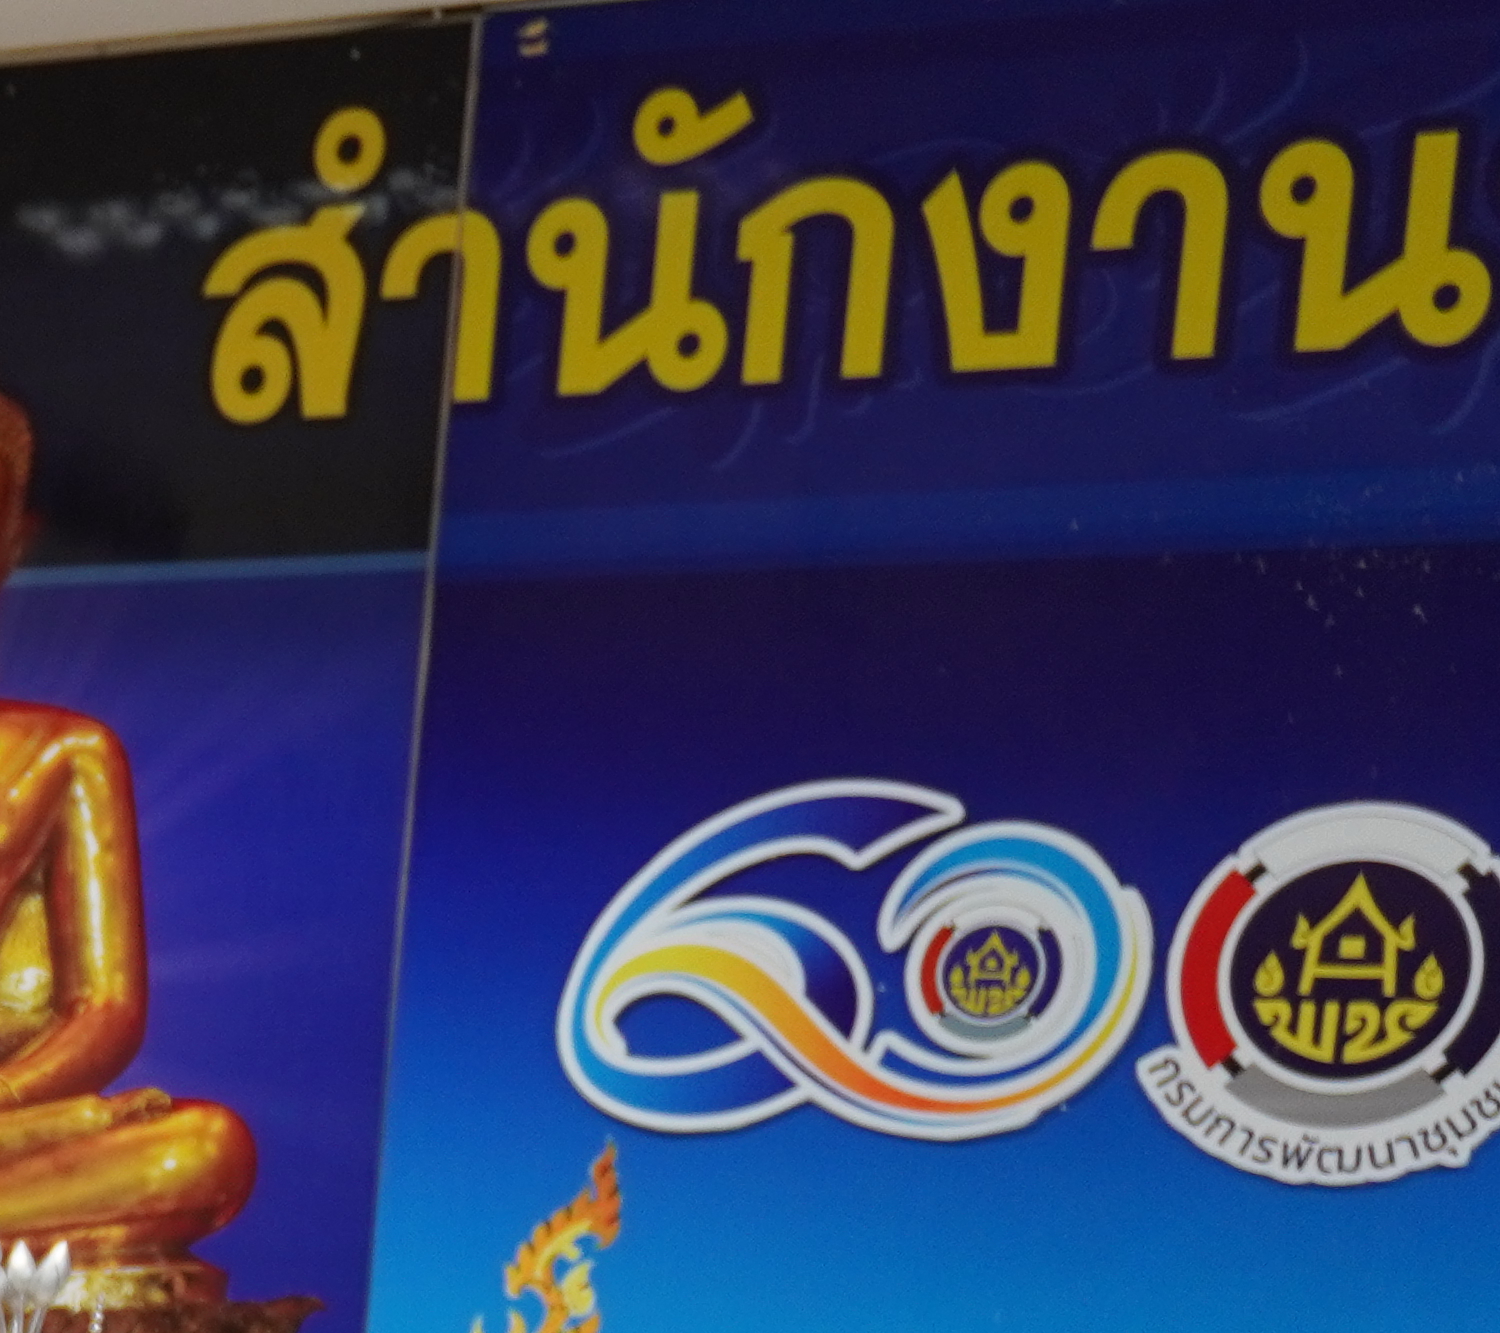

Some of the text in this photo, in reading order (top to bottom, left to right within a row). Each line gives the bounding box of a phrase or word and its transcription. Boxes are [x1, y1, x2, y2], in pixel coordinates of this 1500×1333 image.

[204, 86, 1492, 424] สำนักงาน
[1148, 1056, 1500, 1175] กรมการพัฒนาชุมช
